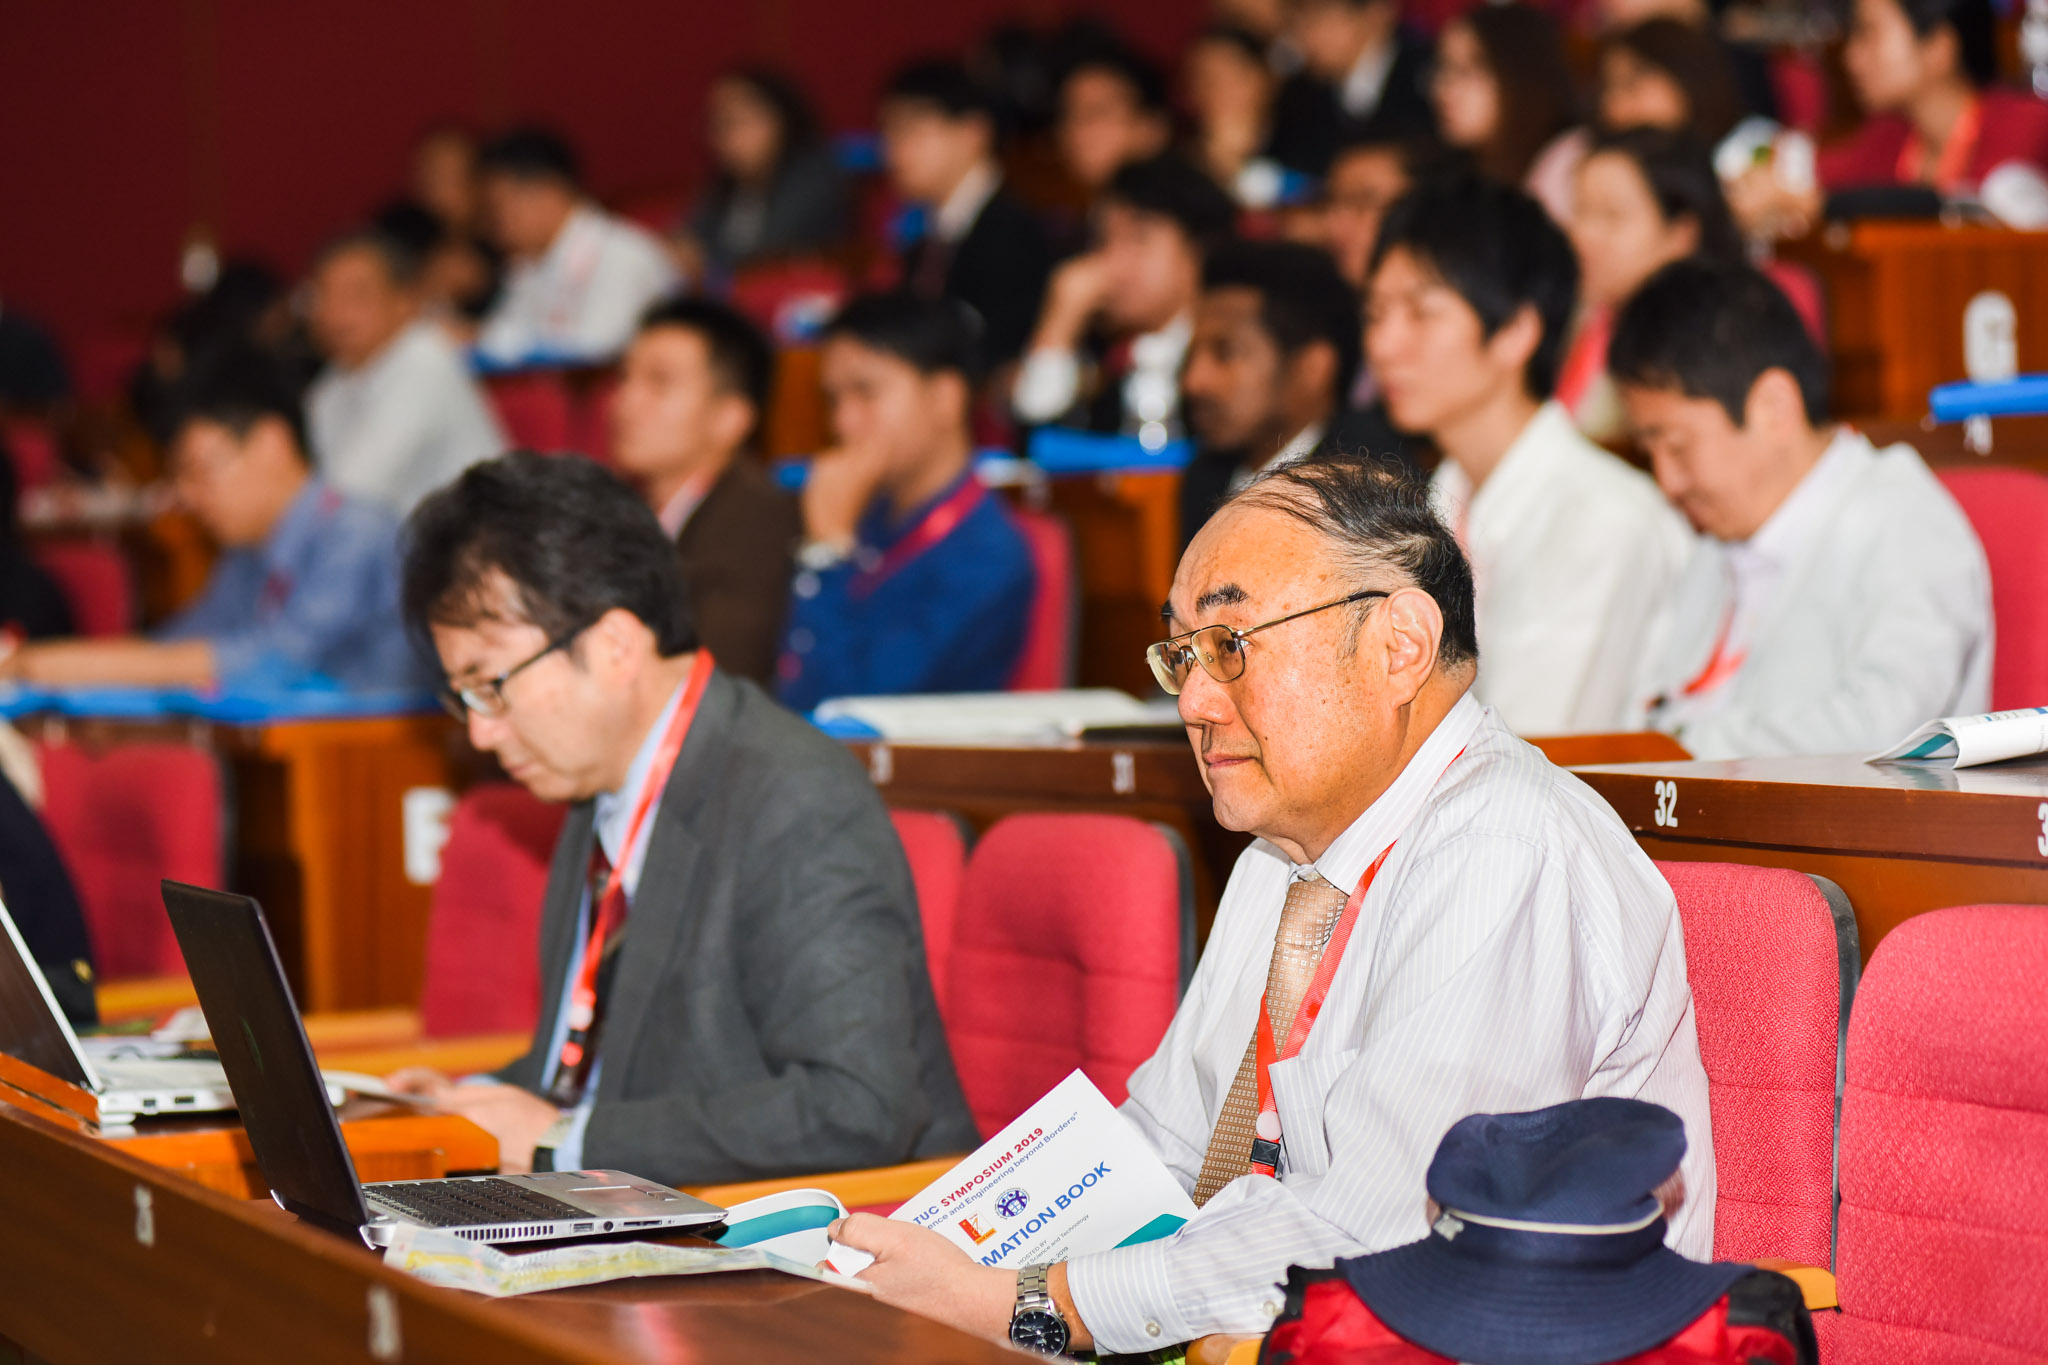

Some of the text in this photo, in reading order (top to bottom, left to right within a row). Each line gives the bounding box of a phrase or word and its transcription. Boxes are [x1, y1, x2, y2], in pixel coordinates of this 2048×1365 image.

[1655, 779, 1678, 828] 32
[927, 1214, 948, 1230] ence
[949, 1202, 966, 1216] and
[965, 1165, 1015, 1205] Engineering
[1014, 1141, 1044, 1168] beyond
[941, 1151, 1014, 1207] SYMPOSIUM
[1014, 1127, 1043, 1153] 2019
[977, 1206, 1057, 1268] MATION
[1054, 1160, 1112, 1211] BOOK
[1030, 1246, 1051, 1264] Science
[1050, 1236, 1061, 1247] and
[1060, 1214, 1089, 1239] Technology
[1018, 1240, 1048, 1265] HOSTED BY
[1055, 1246, 1069, 1258] 2019
